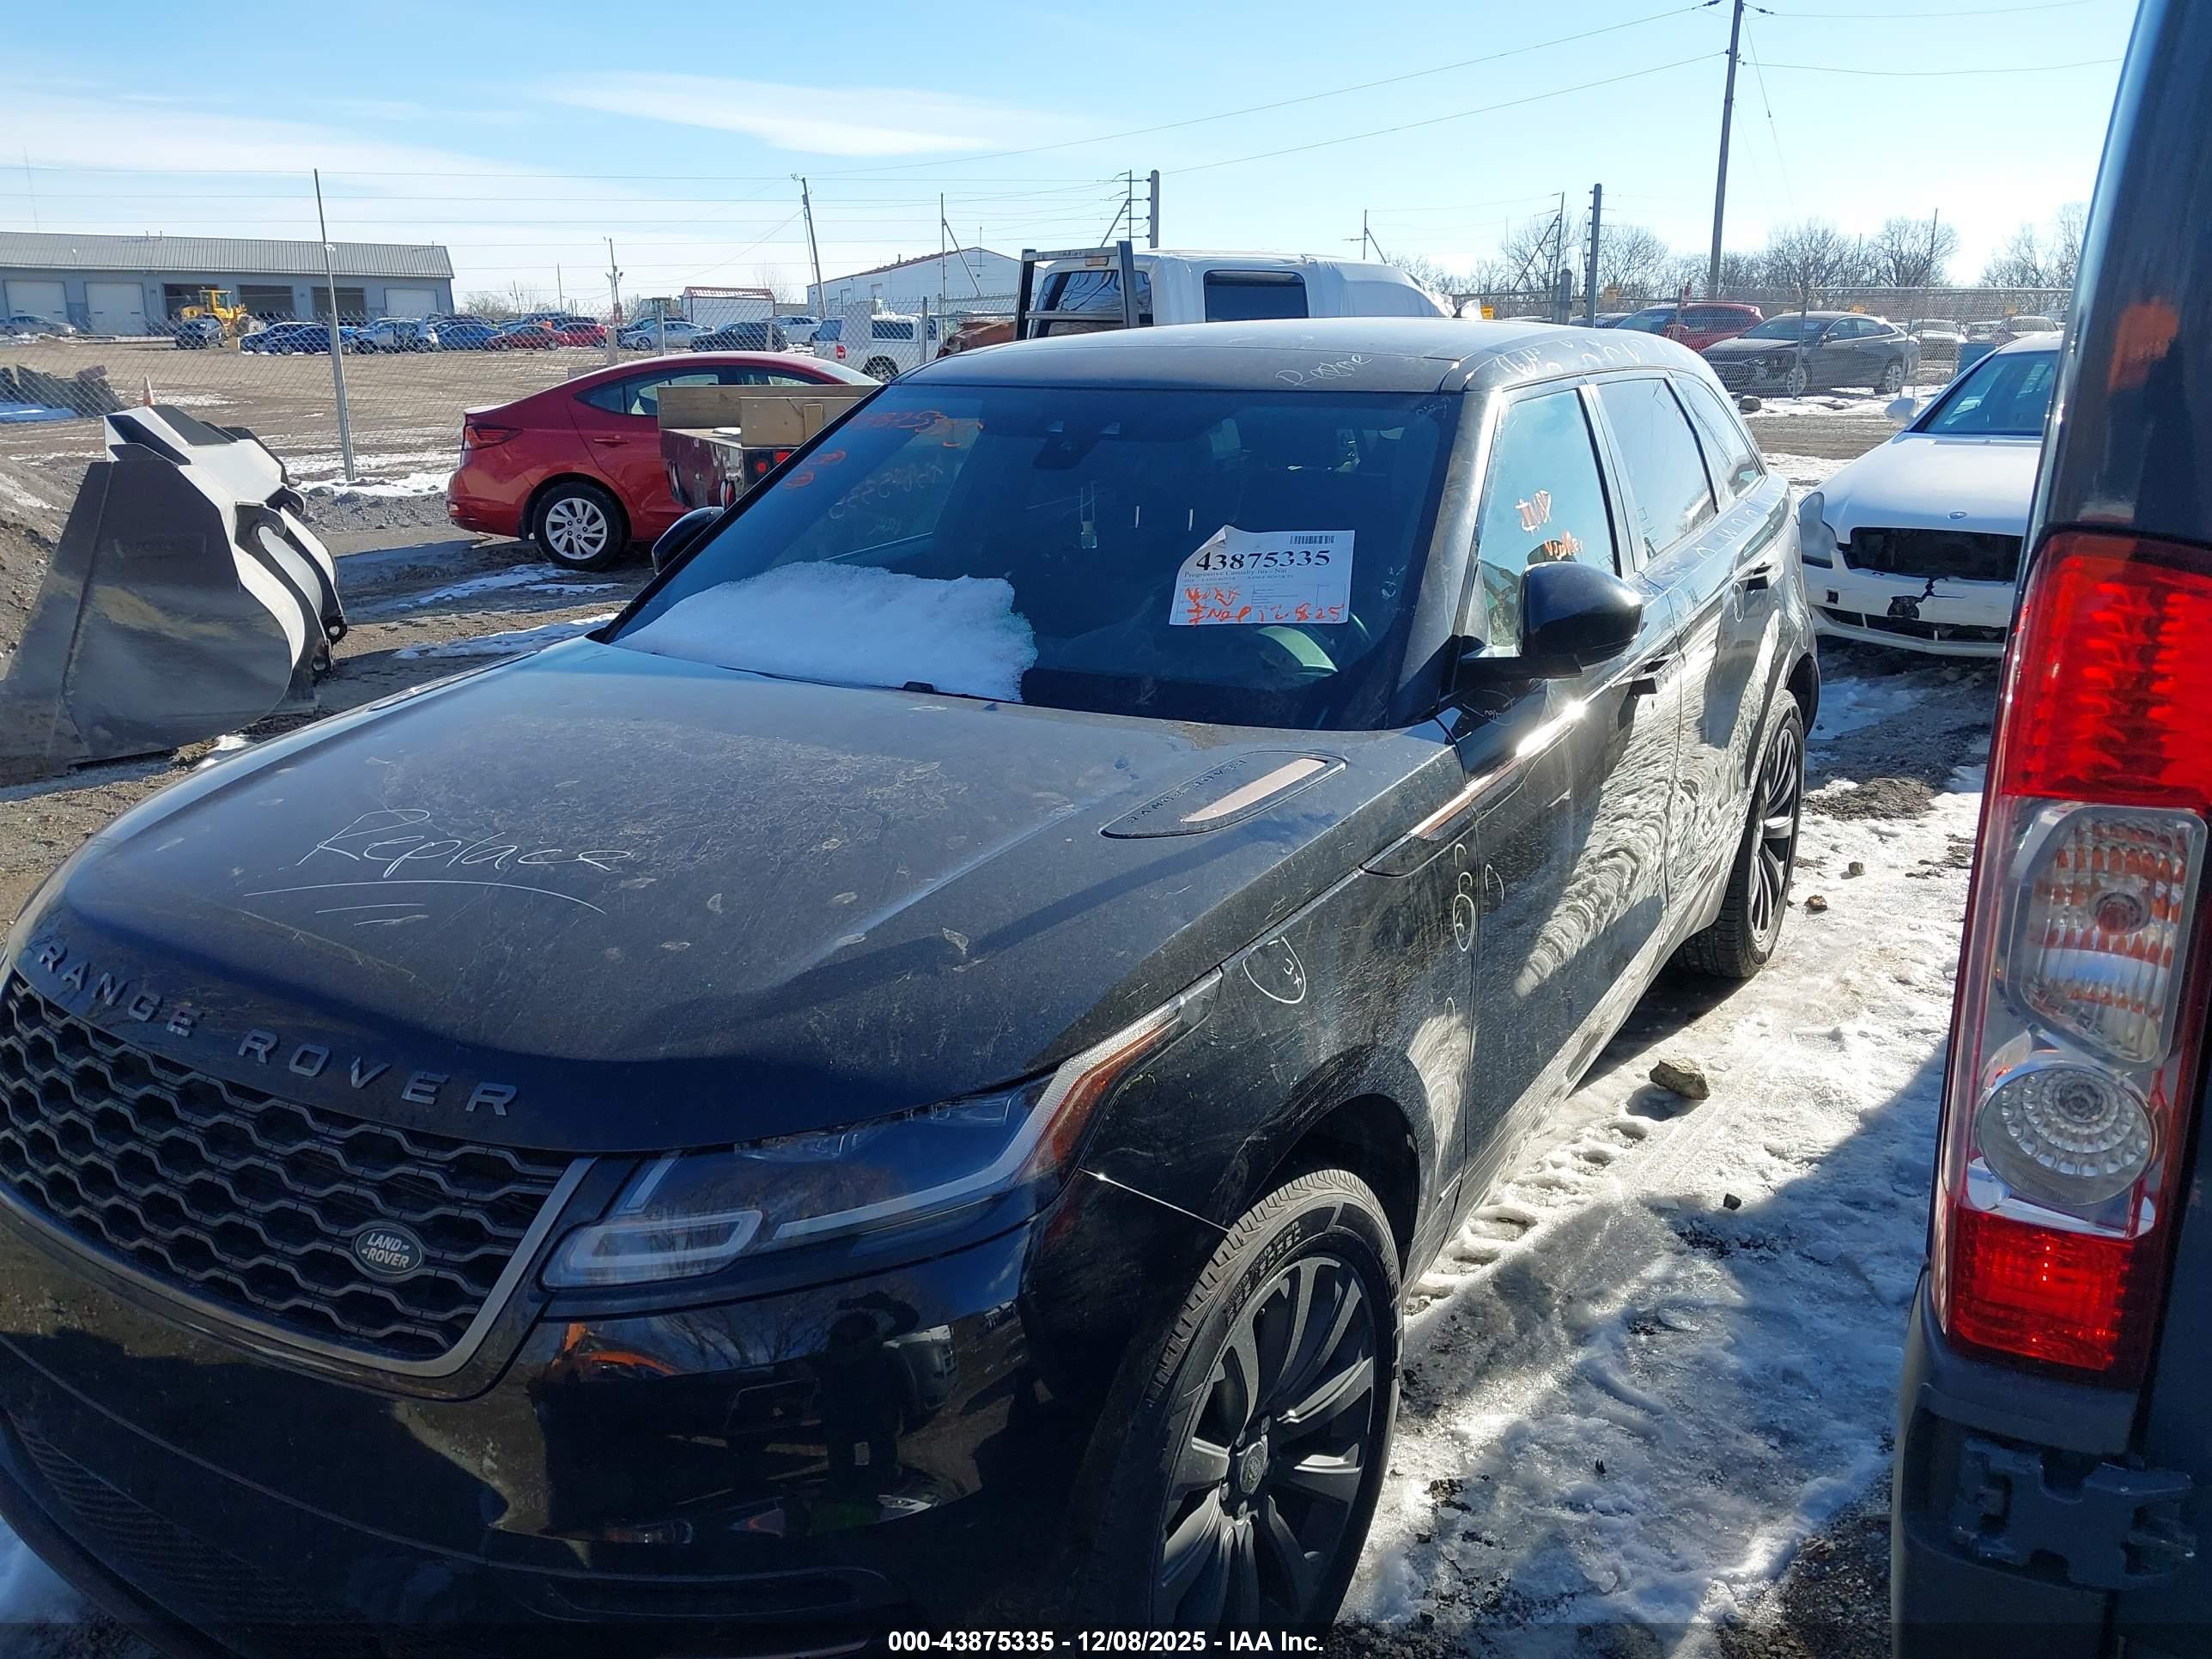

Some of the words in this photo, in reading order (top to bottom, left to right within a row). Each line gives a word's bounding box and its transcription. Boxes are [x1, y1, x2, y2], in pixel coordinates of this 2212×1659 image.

[1196, 550, 1331, 571] 43875335
[39, 944, 206, 1039] RANGE
[237, 1030, 518, 1117] ROVER
[367, 1232, 403, 1251] LAND
[367, 1247, 410, 1268] ROVER
